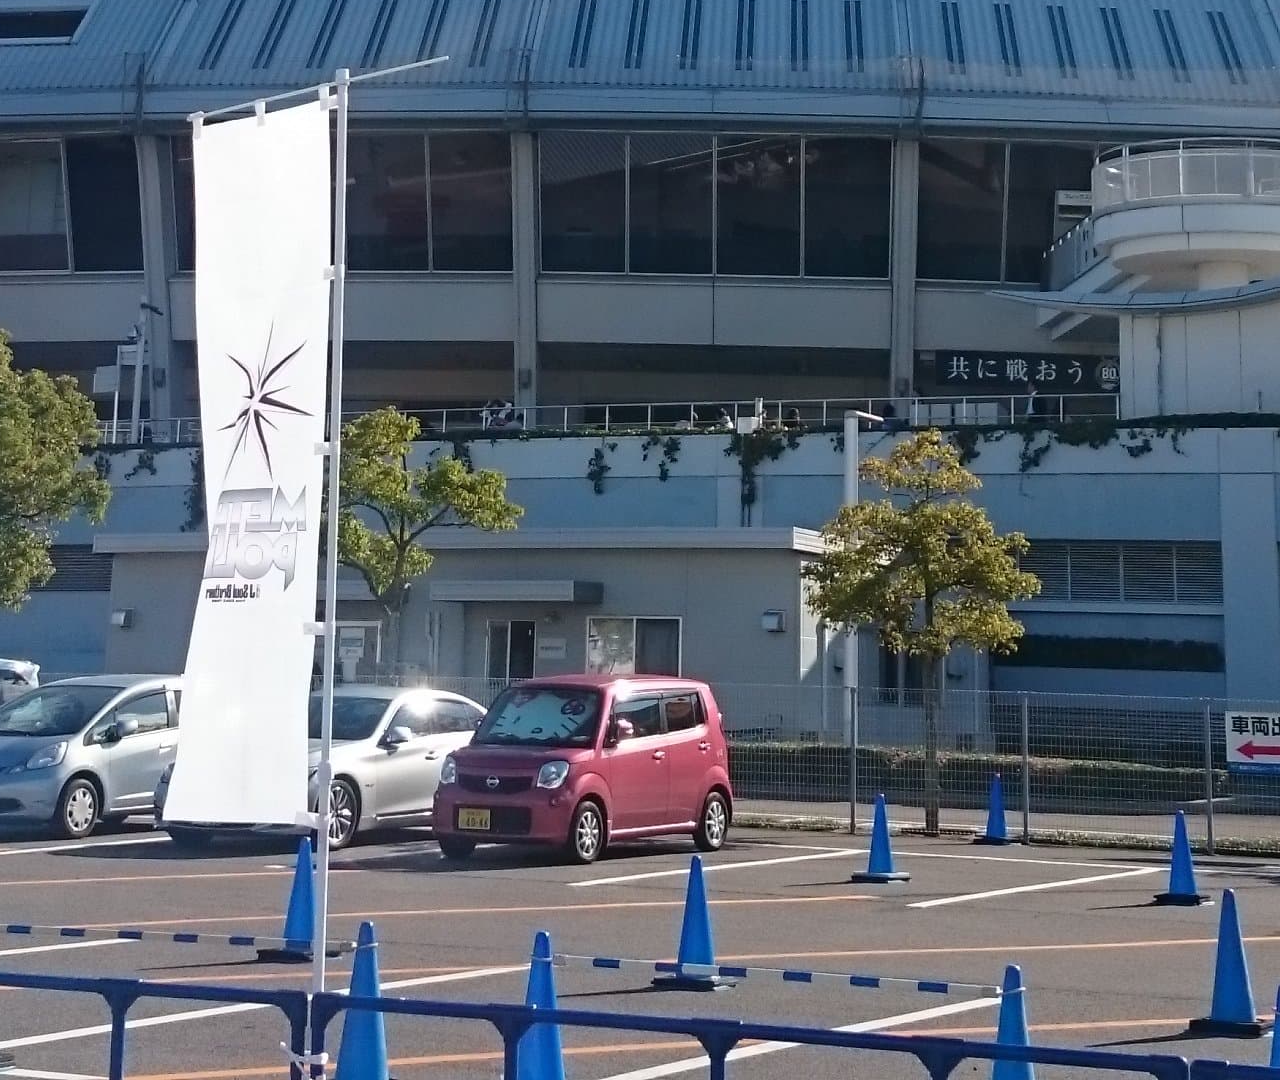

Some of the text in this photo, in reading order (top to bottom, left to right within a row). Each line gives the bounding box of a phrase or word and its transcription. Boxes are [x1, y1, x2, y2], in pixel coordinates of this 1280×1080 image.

[947, 356, 1082, 384] 共に戦おう
